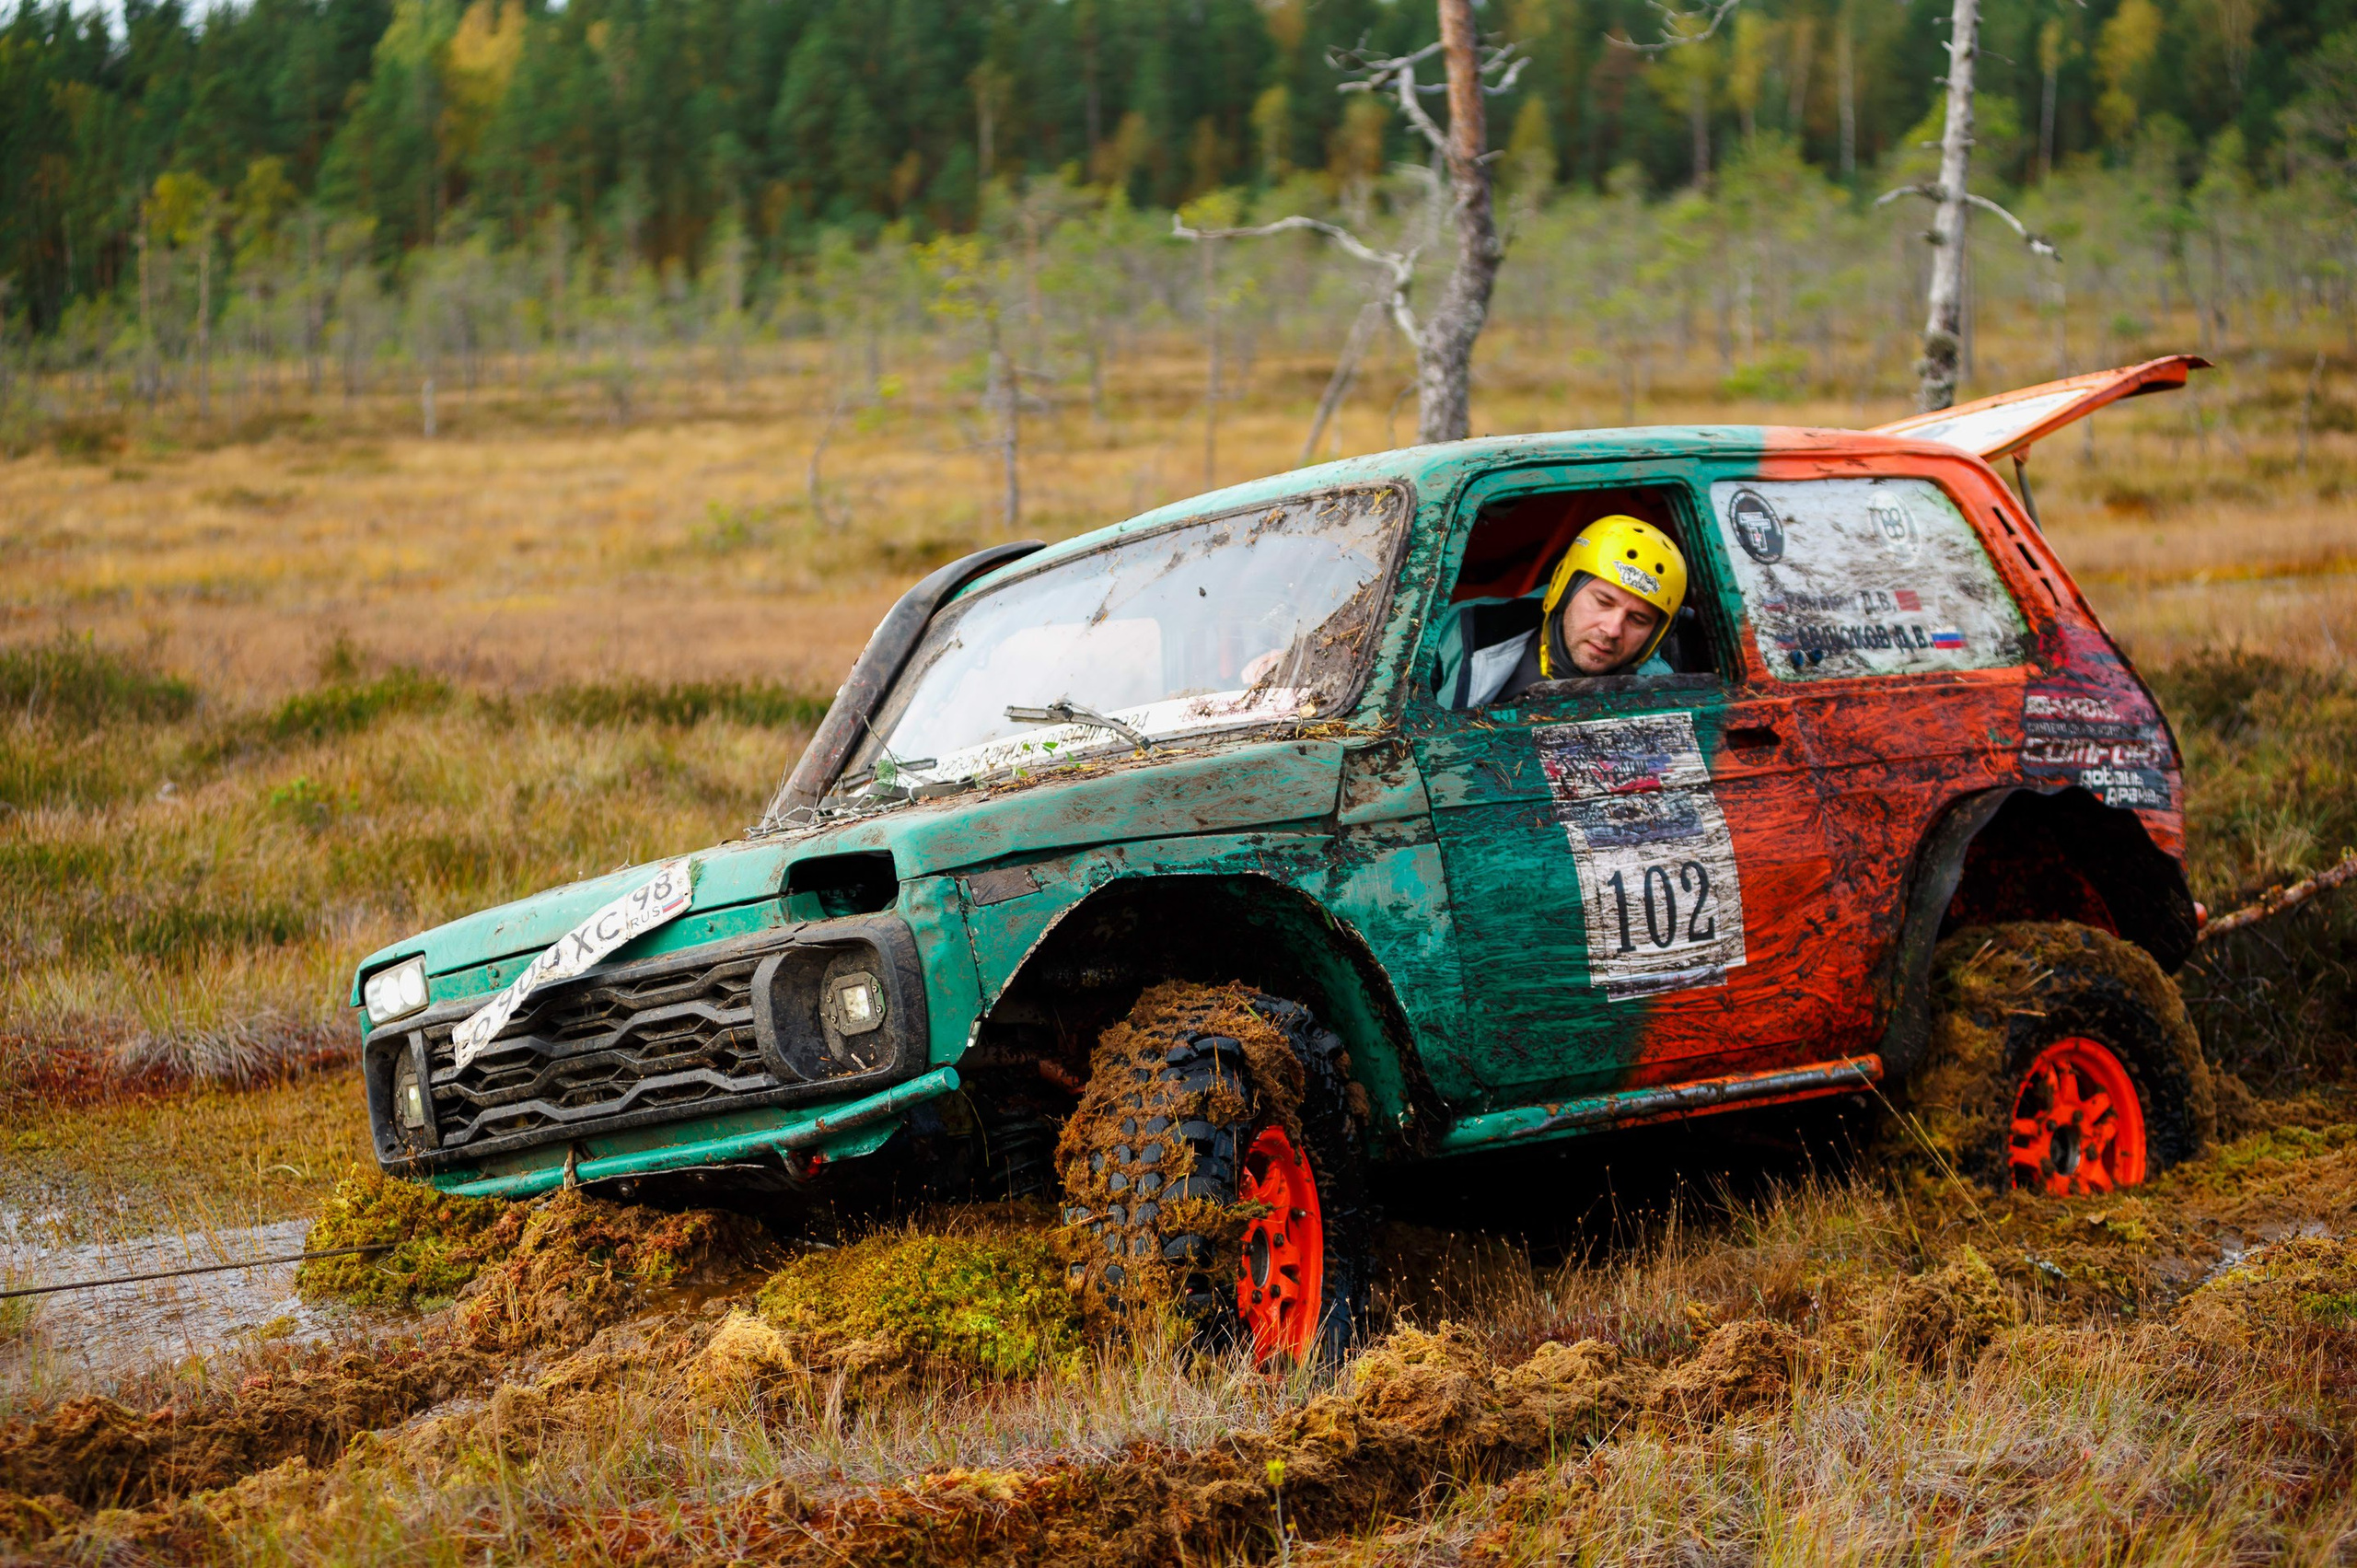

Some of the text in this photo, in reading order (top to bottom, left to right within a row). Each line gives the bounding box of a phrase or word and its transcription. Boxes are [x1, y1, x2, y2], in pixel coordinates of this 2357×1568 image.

[632, 873, 673, 912] 98
[1607, 862, 1716, 952] 102
[630, 905, 662, 930] RUS
